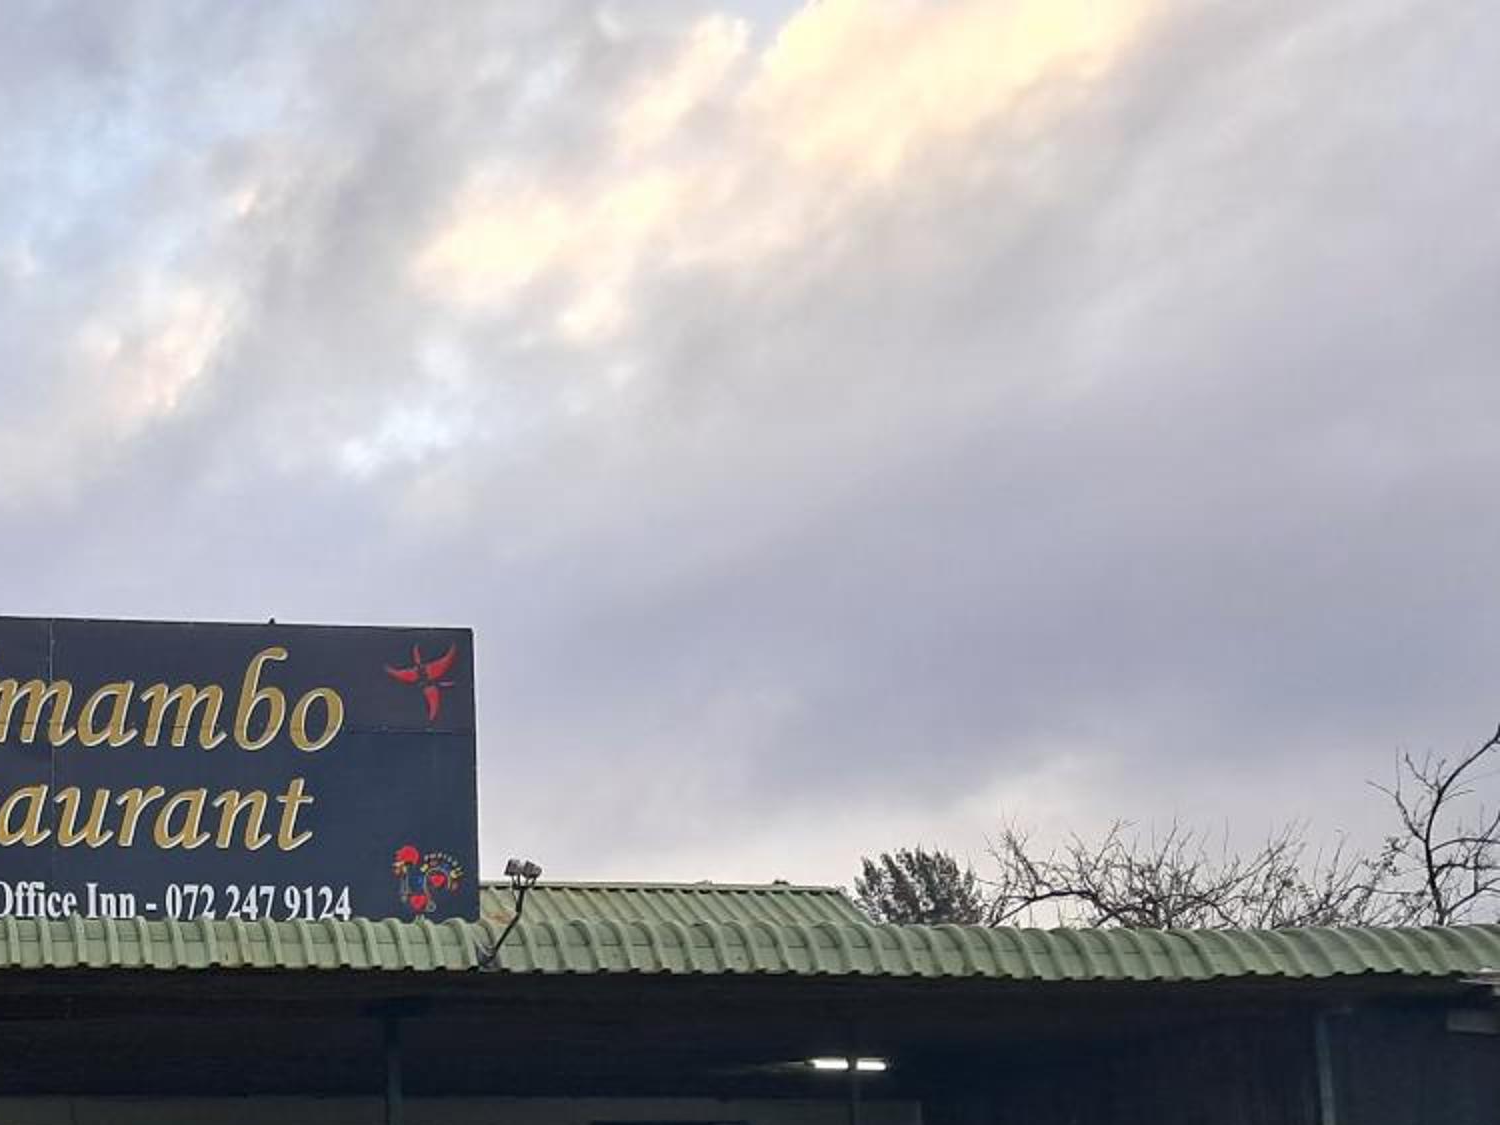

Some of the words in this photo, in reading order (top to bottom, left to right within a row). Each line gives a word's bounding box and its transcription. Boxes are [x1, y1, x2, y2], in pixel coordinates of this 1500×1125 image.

[86, 883, 137, 918] Inn
[165, 884, 216, 921] 072
[225, 885, 276, 921] 247
[285, 886, 352, 922] 9124
